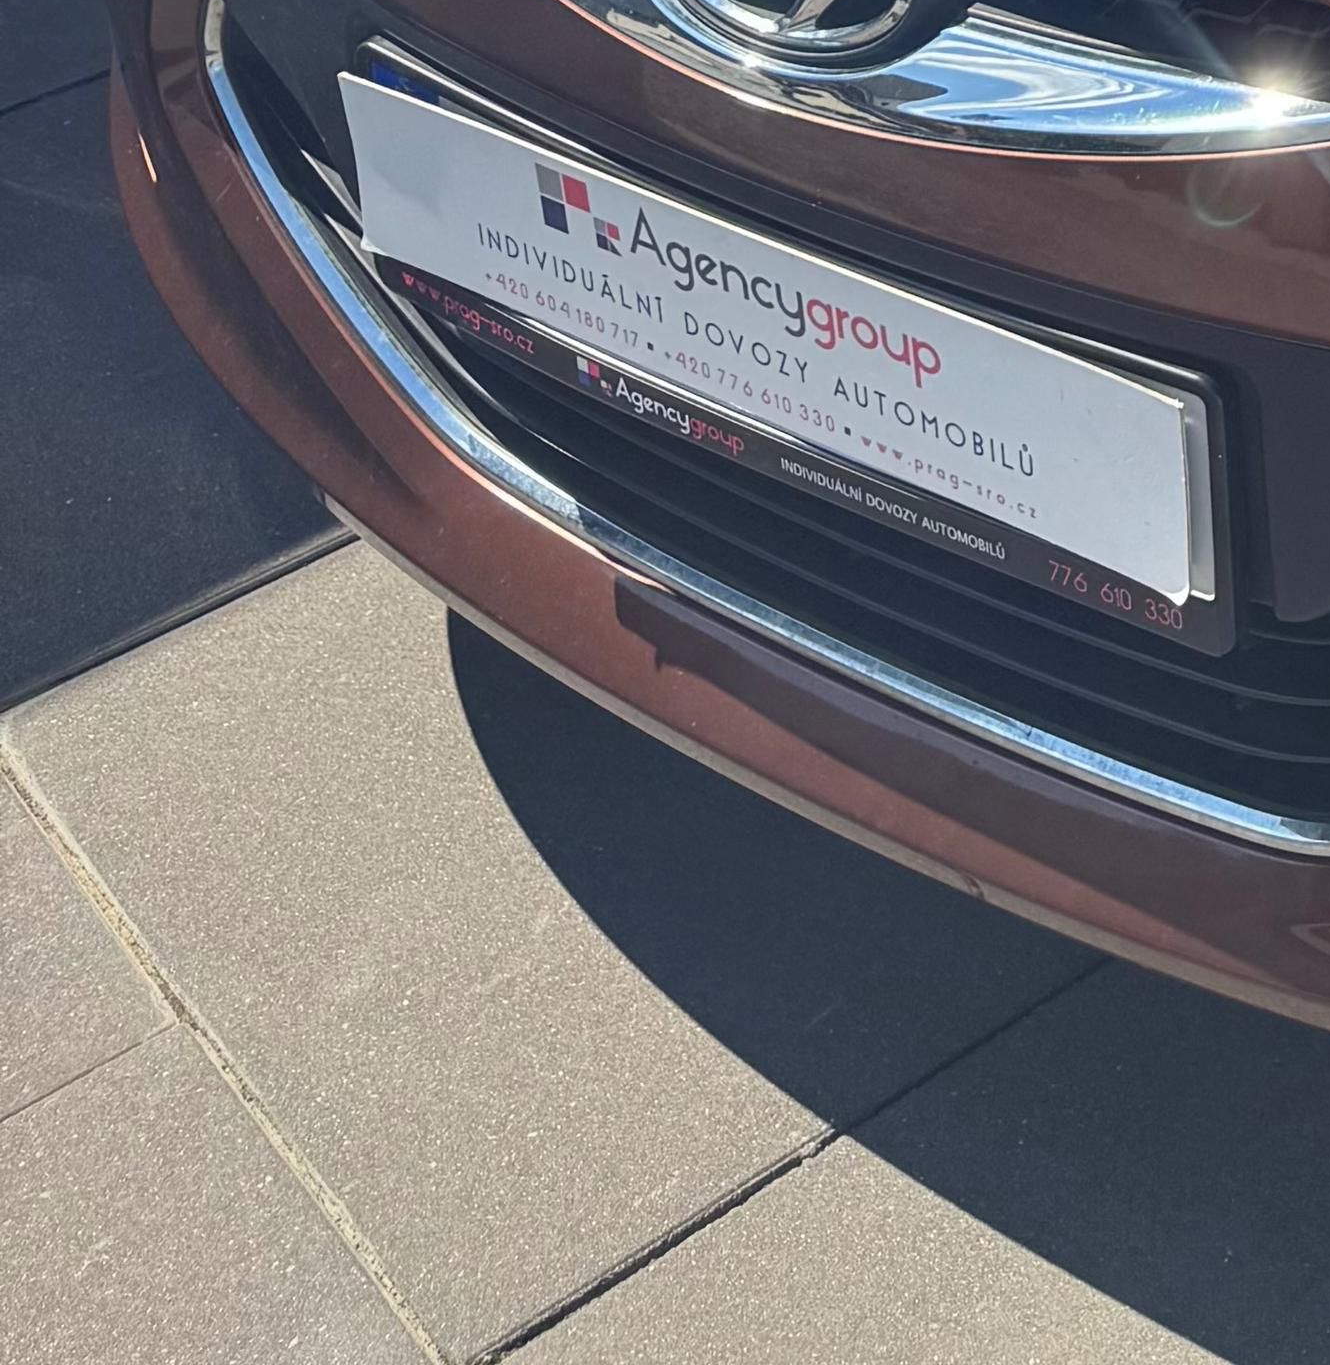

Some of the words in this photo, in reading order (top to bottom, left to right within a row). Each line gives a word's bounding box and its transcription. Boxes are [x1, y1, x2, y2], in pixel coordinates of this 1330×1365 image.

[485, 272, 529, 301] +420
[535, 290, 571, 318] 604
[576, 307, 606, 334] 180
[611, 320, 639, 349] 717
[664, 349, 711, 380] +420
[717, 367, 754, 398] 776
[762, 387, 792, 415] 610
[800, 402, 836, 434] 330
[630, 206, 942, 388] Agencygroup
[684, 311, 808, 384] DOVOZY
[833, 376, 1035, 478] AUTOMOBILŮ
[615, 377, 746, 454] Agencygroup
[866, 492, 918, 526] DOVOZY
[921, 516, 1006, 561] AUTOMOBILŮ
[1048, 560, 1088, 593] 776
[1100, 581, 1132, 612] 610
[1144, 598, 1184, 631] 330
